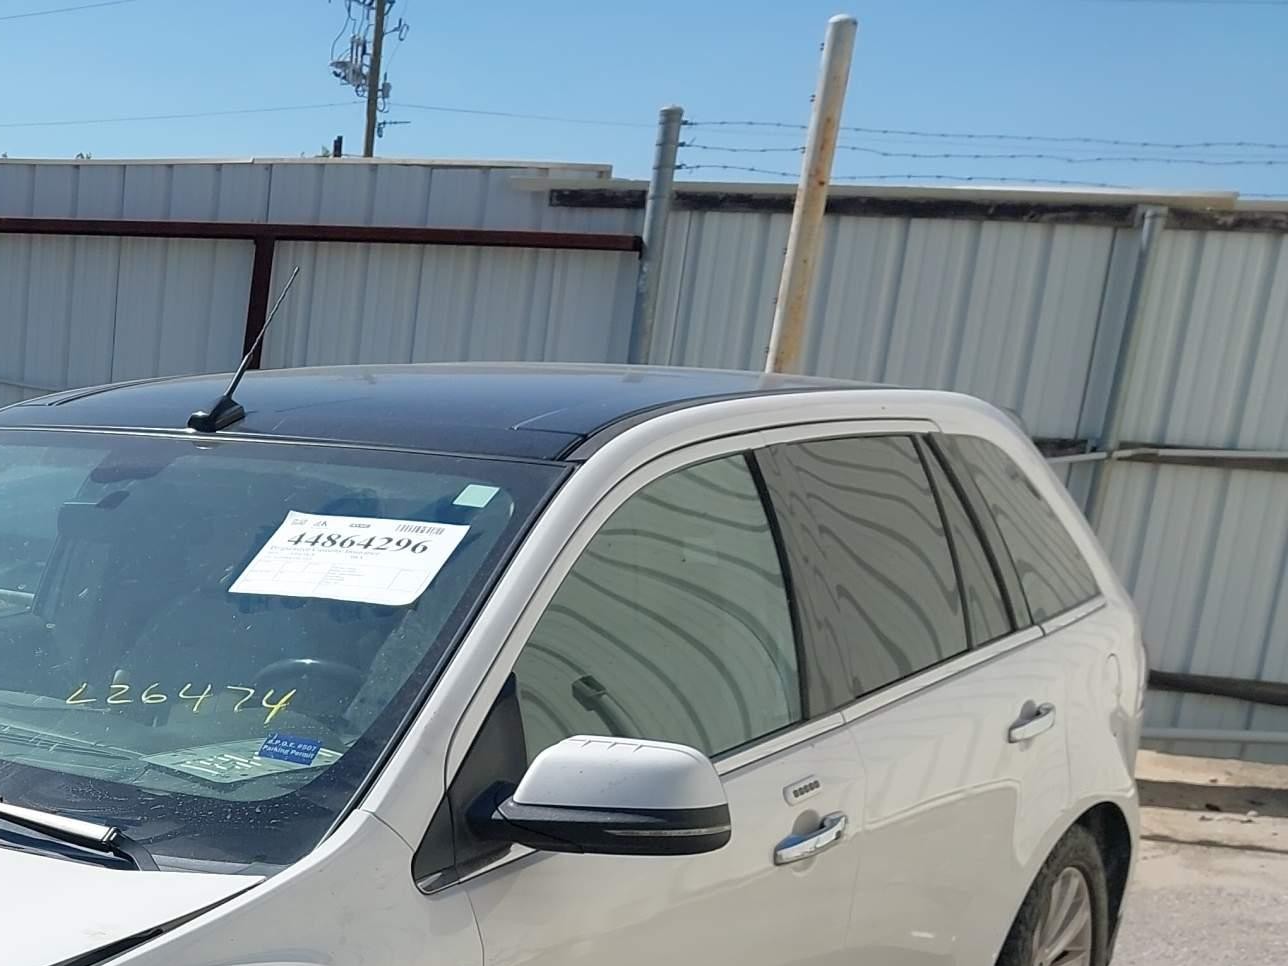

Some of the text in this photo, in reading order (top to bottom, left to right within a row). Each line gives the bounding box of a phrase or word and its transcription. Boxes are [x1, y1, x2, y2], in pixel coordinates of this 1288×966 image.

[287, 531, 431, 553] 44864296
[262, 744, 315, 759] Parking Permit
